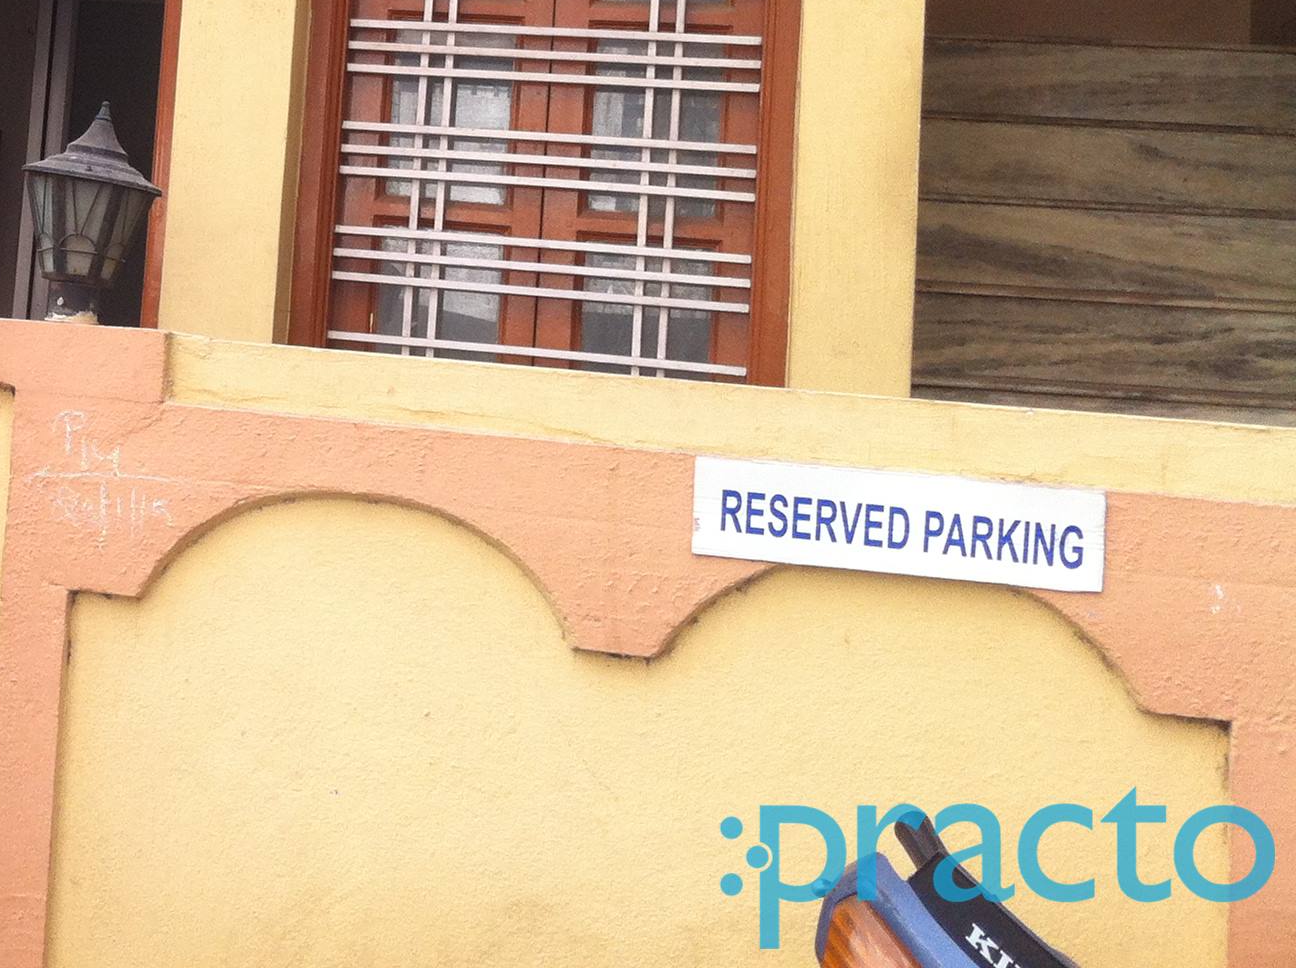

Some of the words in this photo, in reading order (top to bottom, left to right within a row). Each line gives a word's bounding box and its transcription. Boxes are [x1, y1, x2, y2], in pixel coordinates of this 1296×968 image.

[720, 489, 910, 550] RESERVED
[923, 510, 1085, 570] PARKING
[965, 923, 1022, 968] KI
